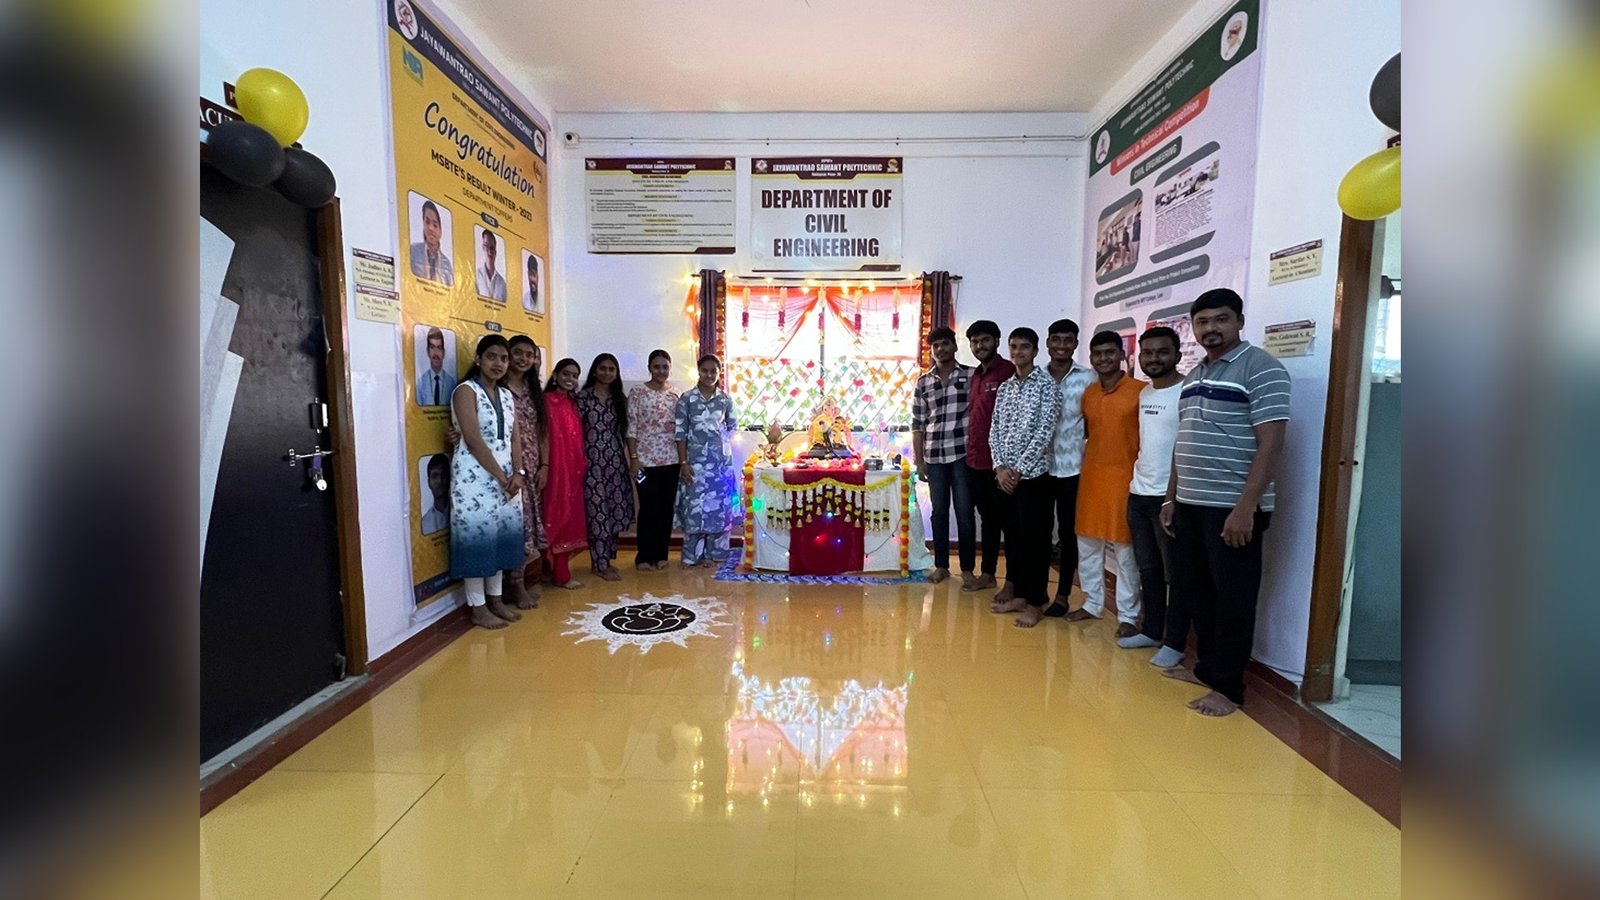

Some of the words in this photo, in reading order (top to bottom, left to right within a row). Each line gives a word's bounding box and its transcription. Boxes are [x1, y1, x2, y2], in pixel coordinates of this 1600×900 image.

[420, 27, 474, 85] JAYAWANTRAO
[475, 78, 501, 111] SAWANT
[1164, 99, 1200, 131] Competition
[424, 102, 535, 198] Congratulation
[1145, 143, 1178, 171] ENGINEERING
[431, 149, 466, 180] MSBTE'S
[466, 172, 492, 195] RESULT
[492, 189, 516, 211] WINTER
[773, 164, 816, 172] JAYAWANTRAO
[816, 164, 842, 172] SAWANT
[842, 164, 883, 172] POLYTECHNIC
[761, 189, 868, 208] DEPARTMENT
[872, 189, 892, 208] OF
[805, 214, 848, 233] CIVIL
[773, 238, 879, 257] ENGINEERING
